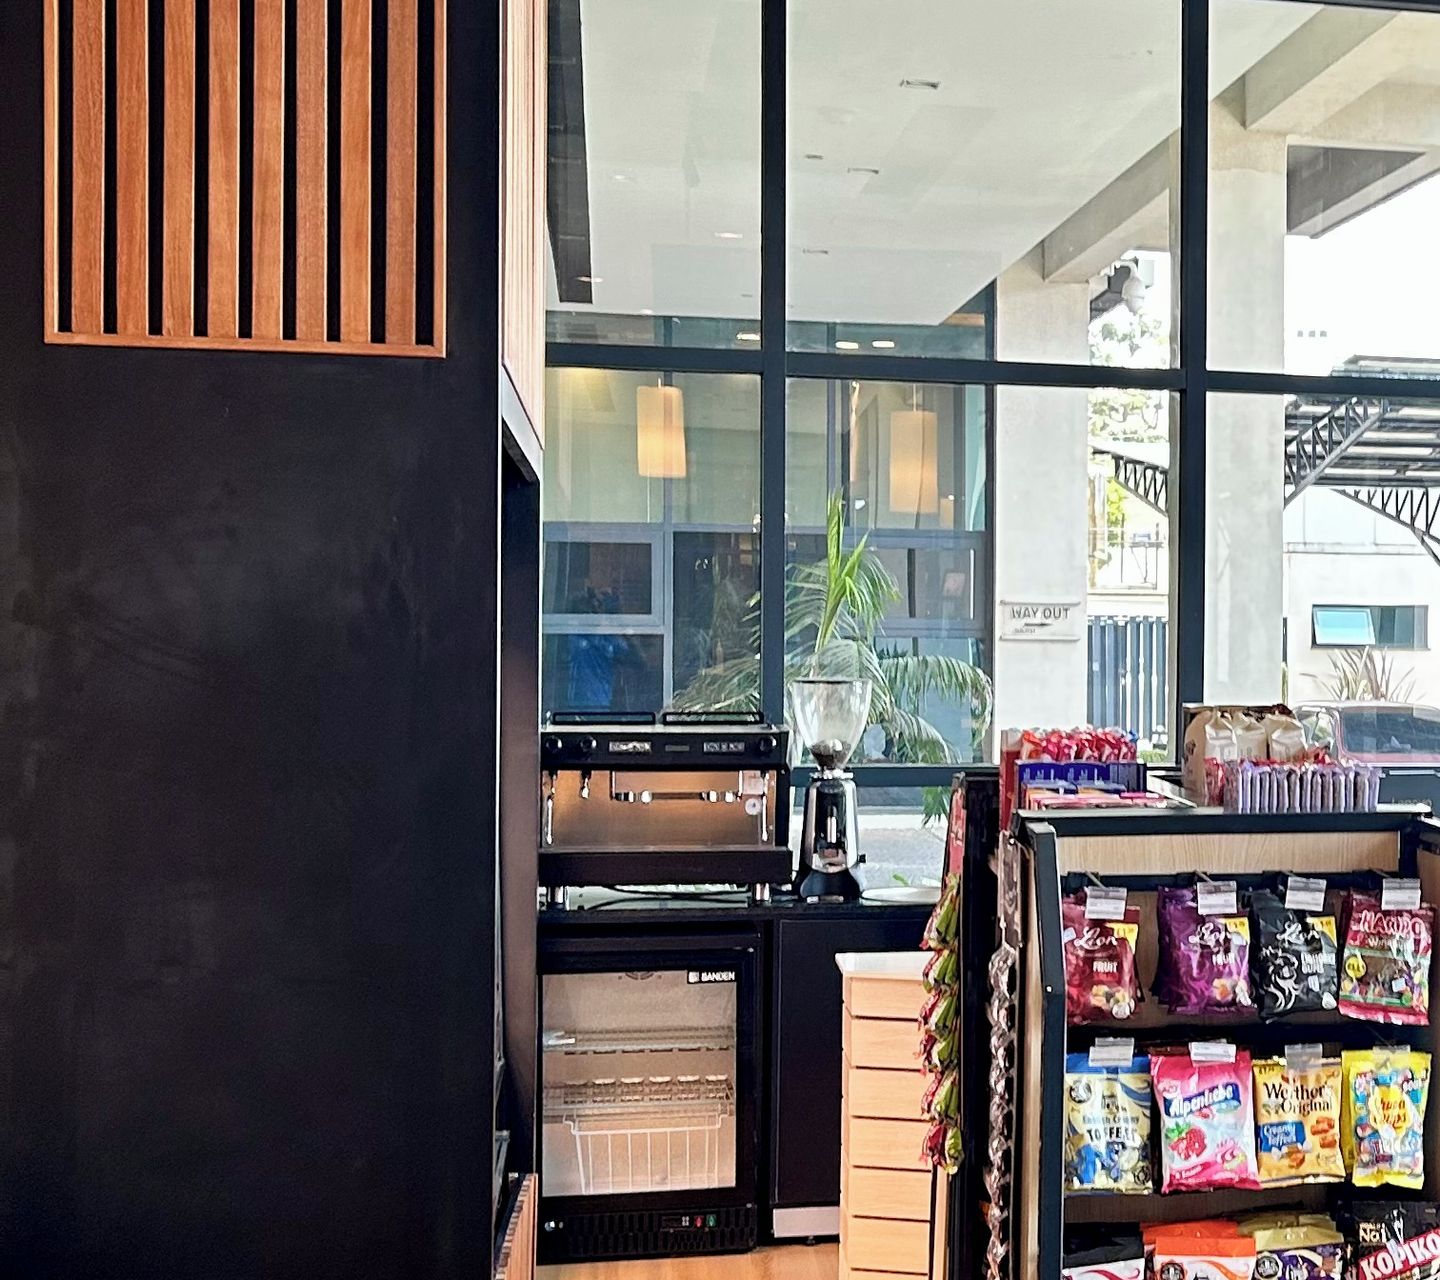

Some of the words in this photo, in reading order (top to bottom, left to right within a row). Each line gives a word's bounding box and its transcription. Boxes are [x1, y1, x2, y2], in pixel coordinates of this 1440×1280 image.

[1011, 607, 1039, 619] WAY
[1043, 607, 1071, 619] OUT
[1074, 926, 1118, 951] Lion
[1093, 960, 1118, 973] FRUIT
[1169, 1084, 1235, 1117] Alpenliebe
